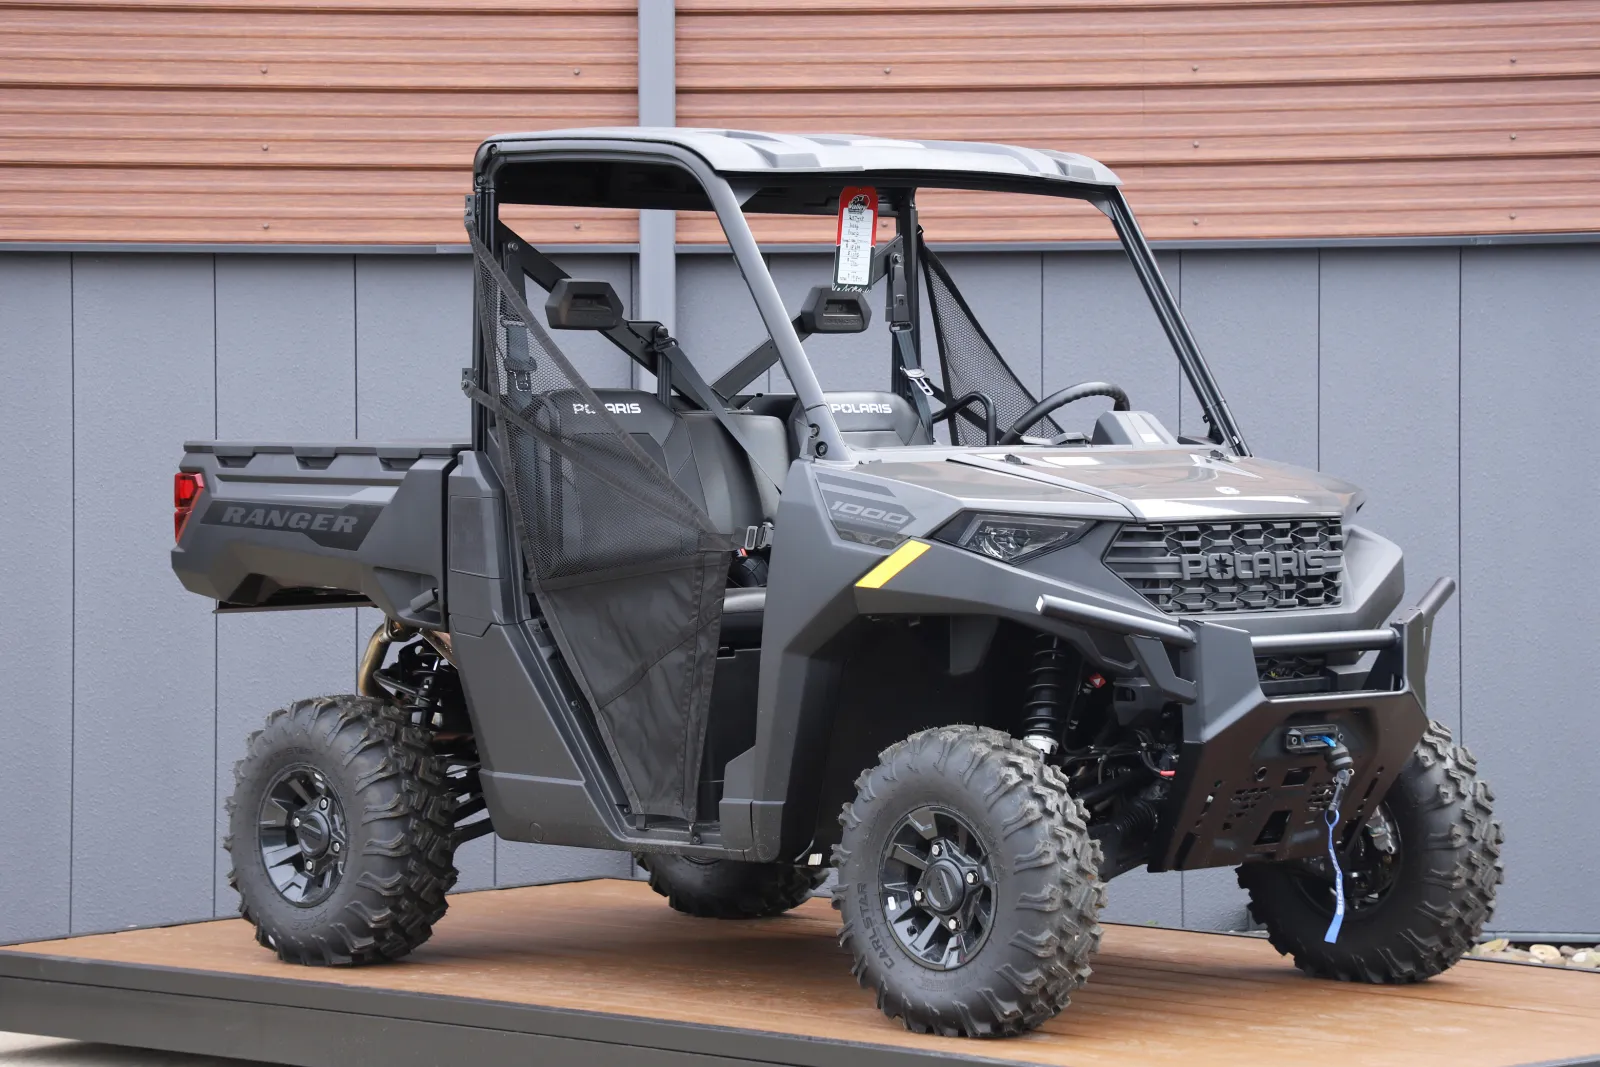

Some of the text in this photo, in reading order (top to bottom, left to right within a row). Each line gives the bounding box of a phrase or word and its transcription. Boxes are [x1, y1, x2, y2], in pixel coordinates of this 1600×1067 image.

[829, 403, 893, 415] POLARIS
[220, 505, 358, 533] RANGER
[830, 500, 909, 524] 1000
[1180, 550, 1326, 580] POLARIS
[856, 882, 896, 970] CARLSTAR
